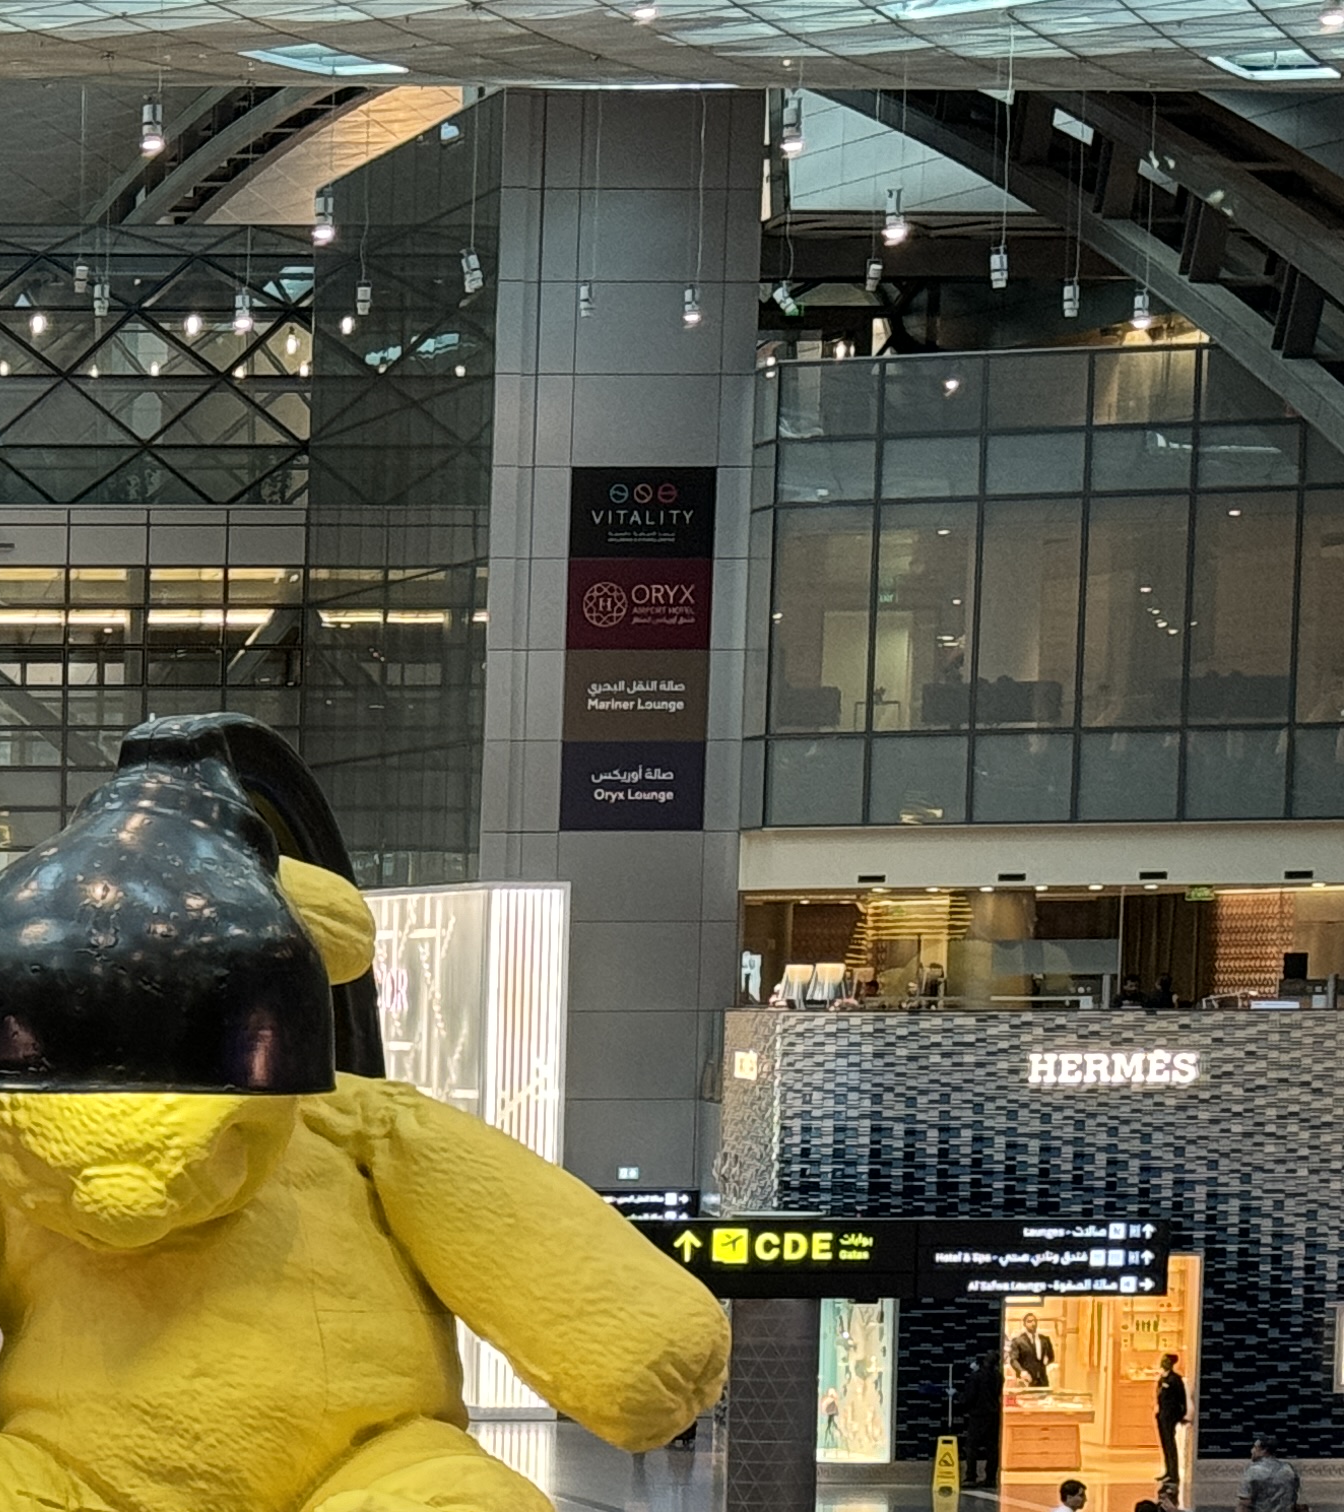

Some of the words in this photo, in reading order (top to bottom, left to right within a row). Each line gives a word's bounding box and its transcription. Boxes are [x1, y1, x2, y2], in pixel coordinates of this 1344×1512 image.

[591, 509, 694, 526] VITALITY
[632, 583, 695, 605] ORYX
[626, 679, 658, 695] النقل
[658, 679, 686, 692] صالة
[587, 698, 636, 711] Mariner
[636, 697, 685, 713] Lounge
[644, 767, 675, 781] صالة
[593, 788, 626, 805] Oryx
[627, 788, 675, 804] Lounge
[754, 1231, 834, 1262] CDE
